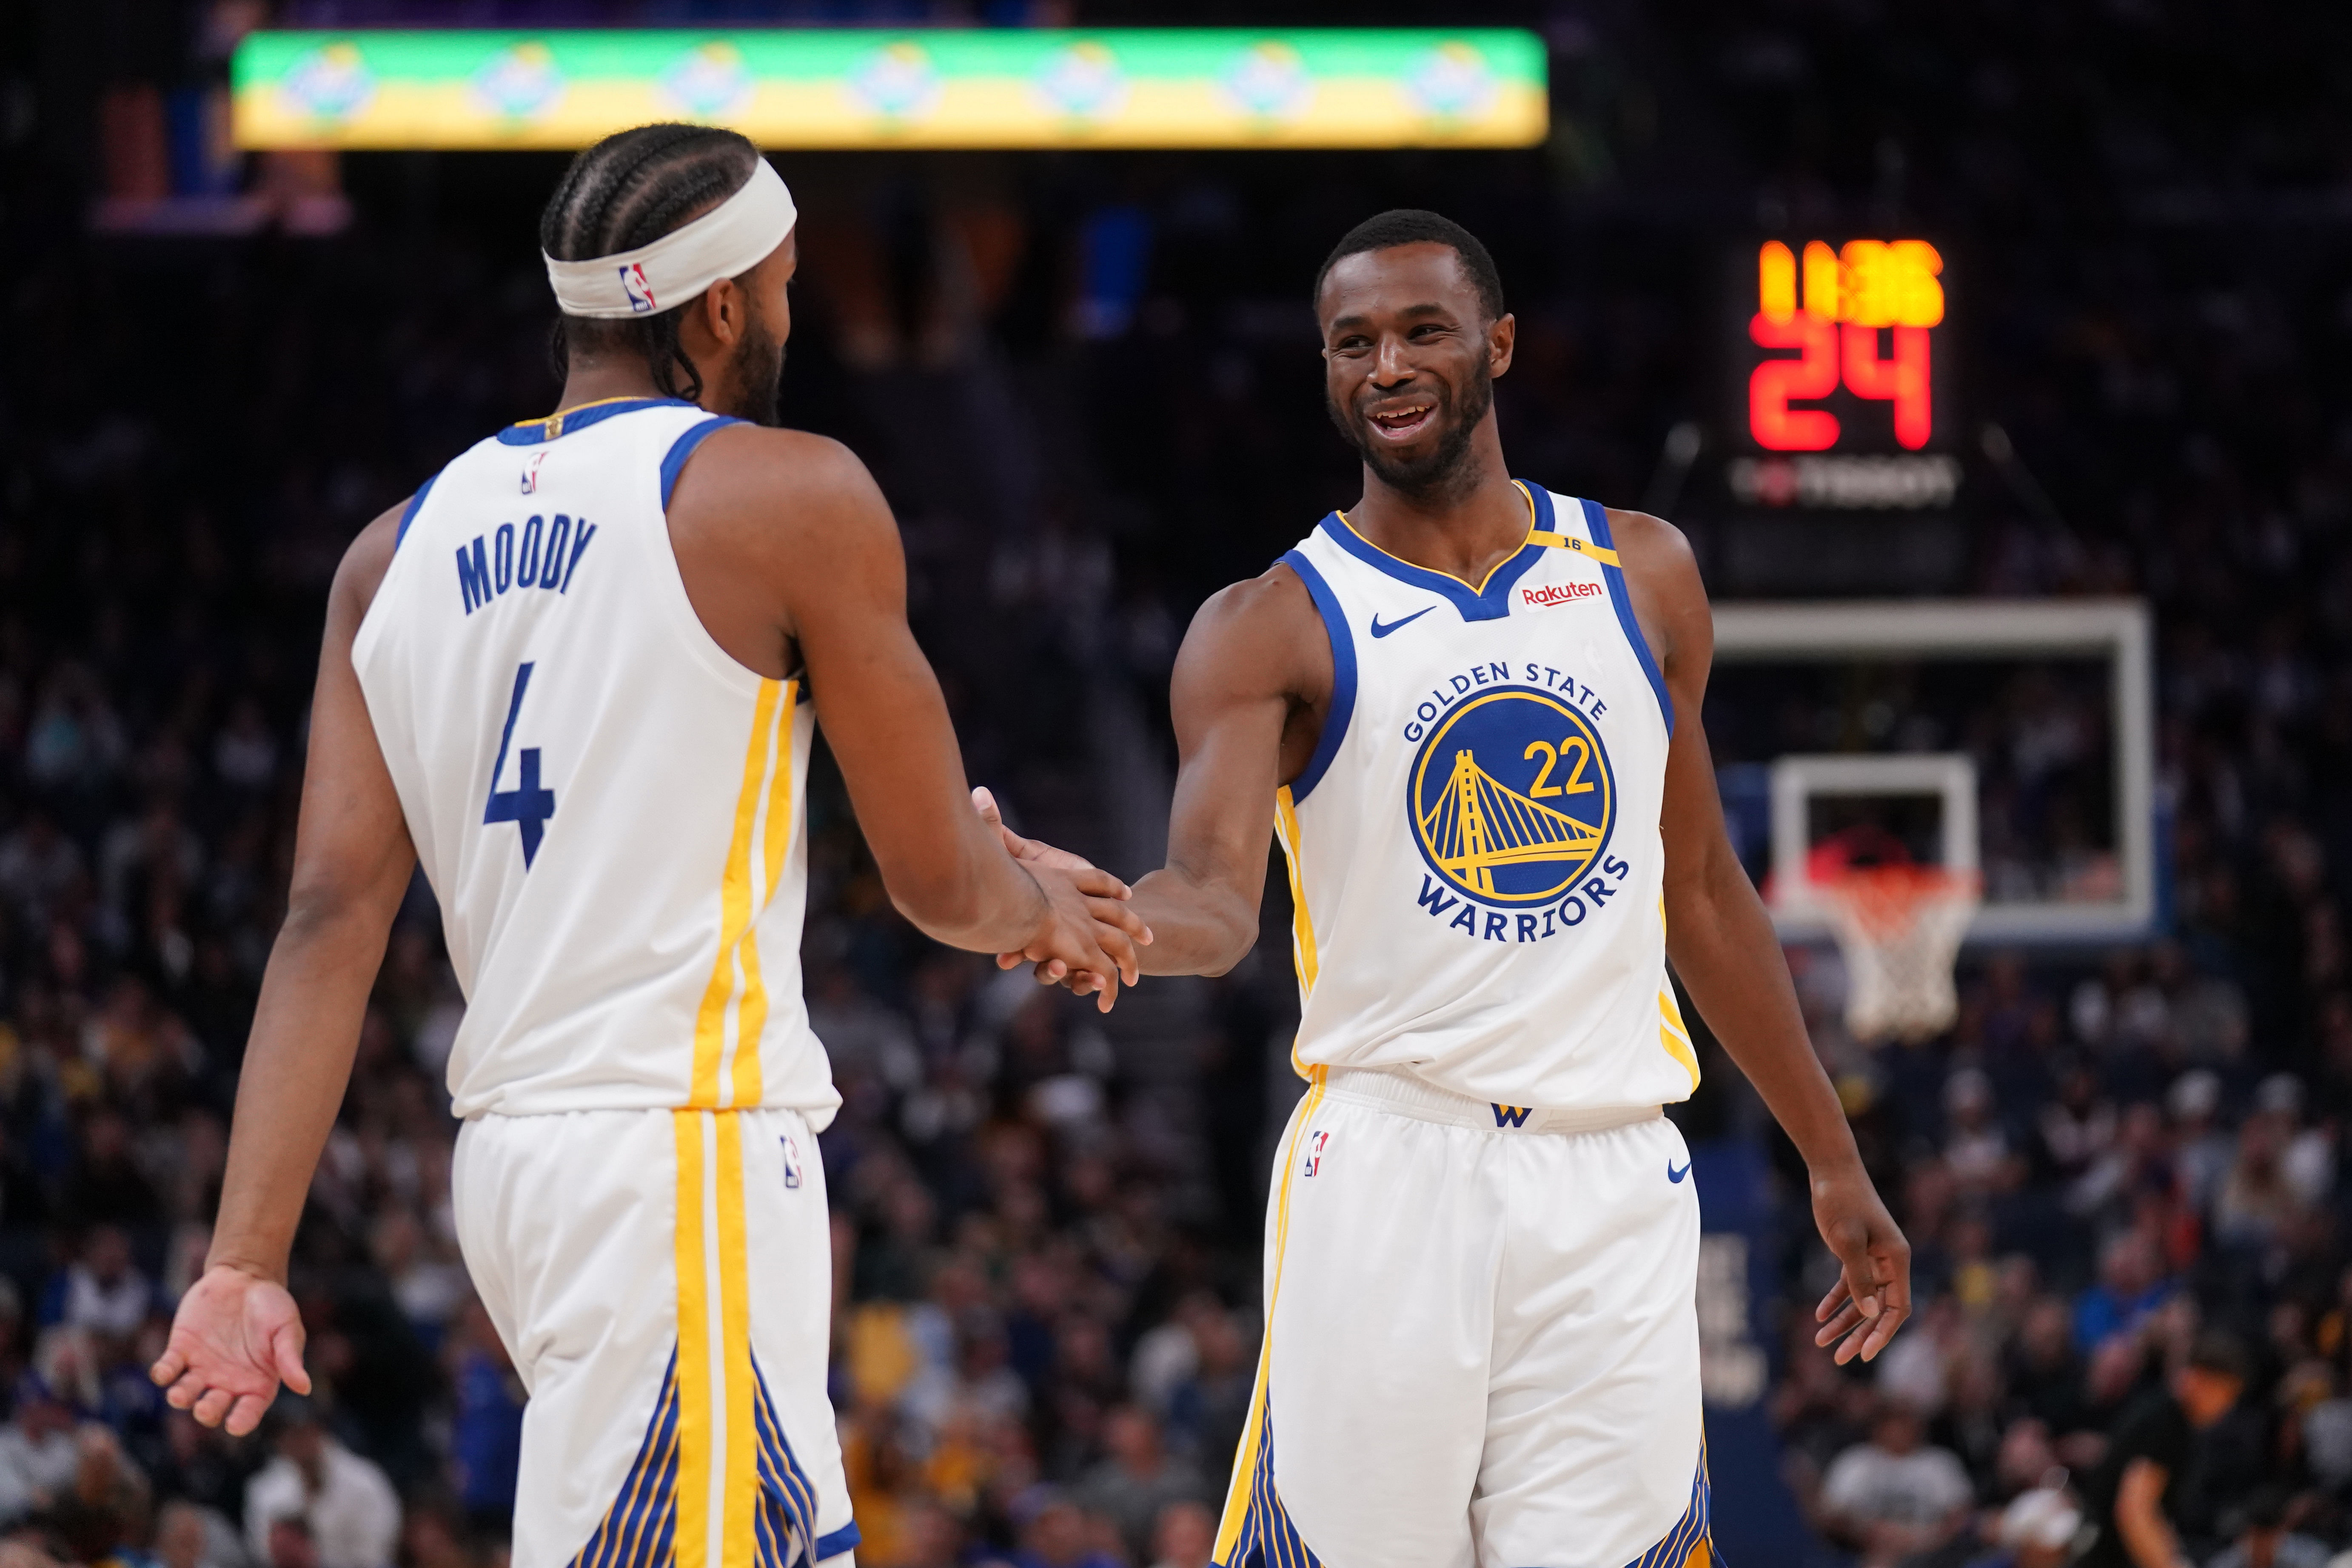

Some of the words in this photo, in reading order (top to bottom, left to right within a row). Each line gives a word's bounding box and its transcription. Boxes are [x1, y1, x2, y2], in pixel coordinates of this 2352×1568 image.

[1749, 310, 1931, 450] 24
[456, 514, 597, 616] MOODY
[1564, 537, 1582, 550] 16
[1522, 582, 1602, 605] Rakuten
[1404, 662, 1510, 742] GOLDEN
[1525, 663, 1608, 721] STATE
[483, 661, 556, 874] 4
[1524, 736, 1595, 798] 22
[1417, 854, 1630, 943] WARRIORS
[1490, 1102, 1534, 1128] W
